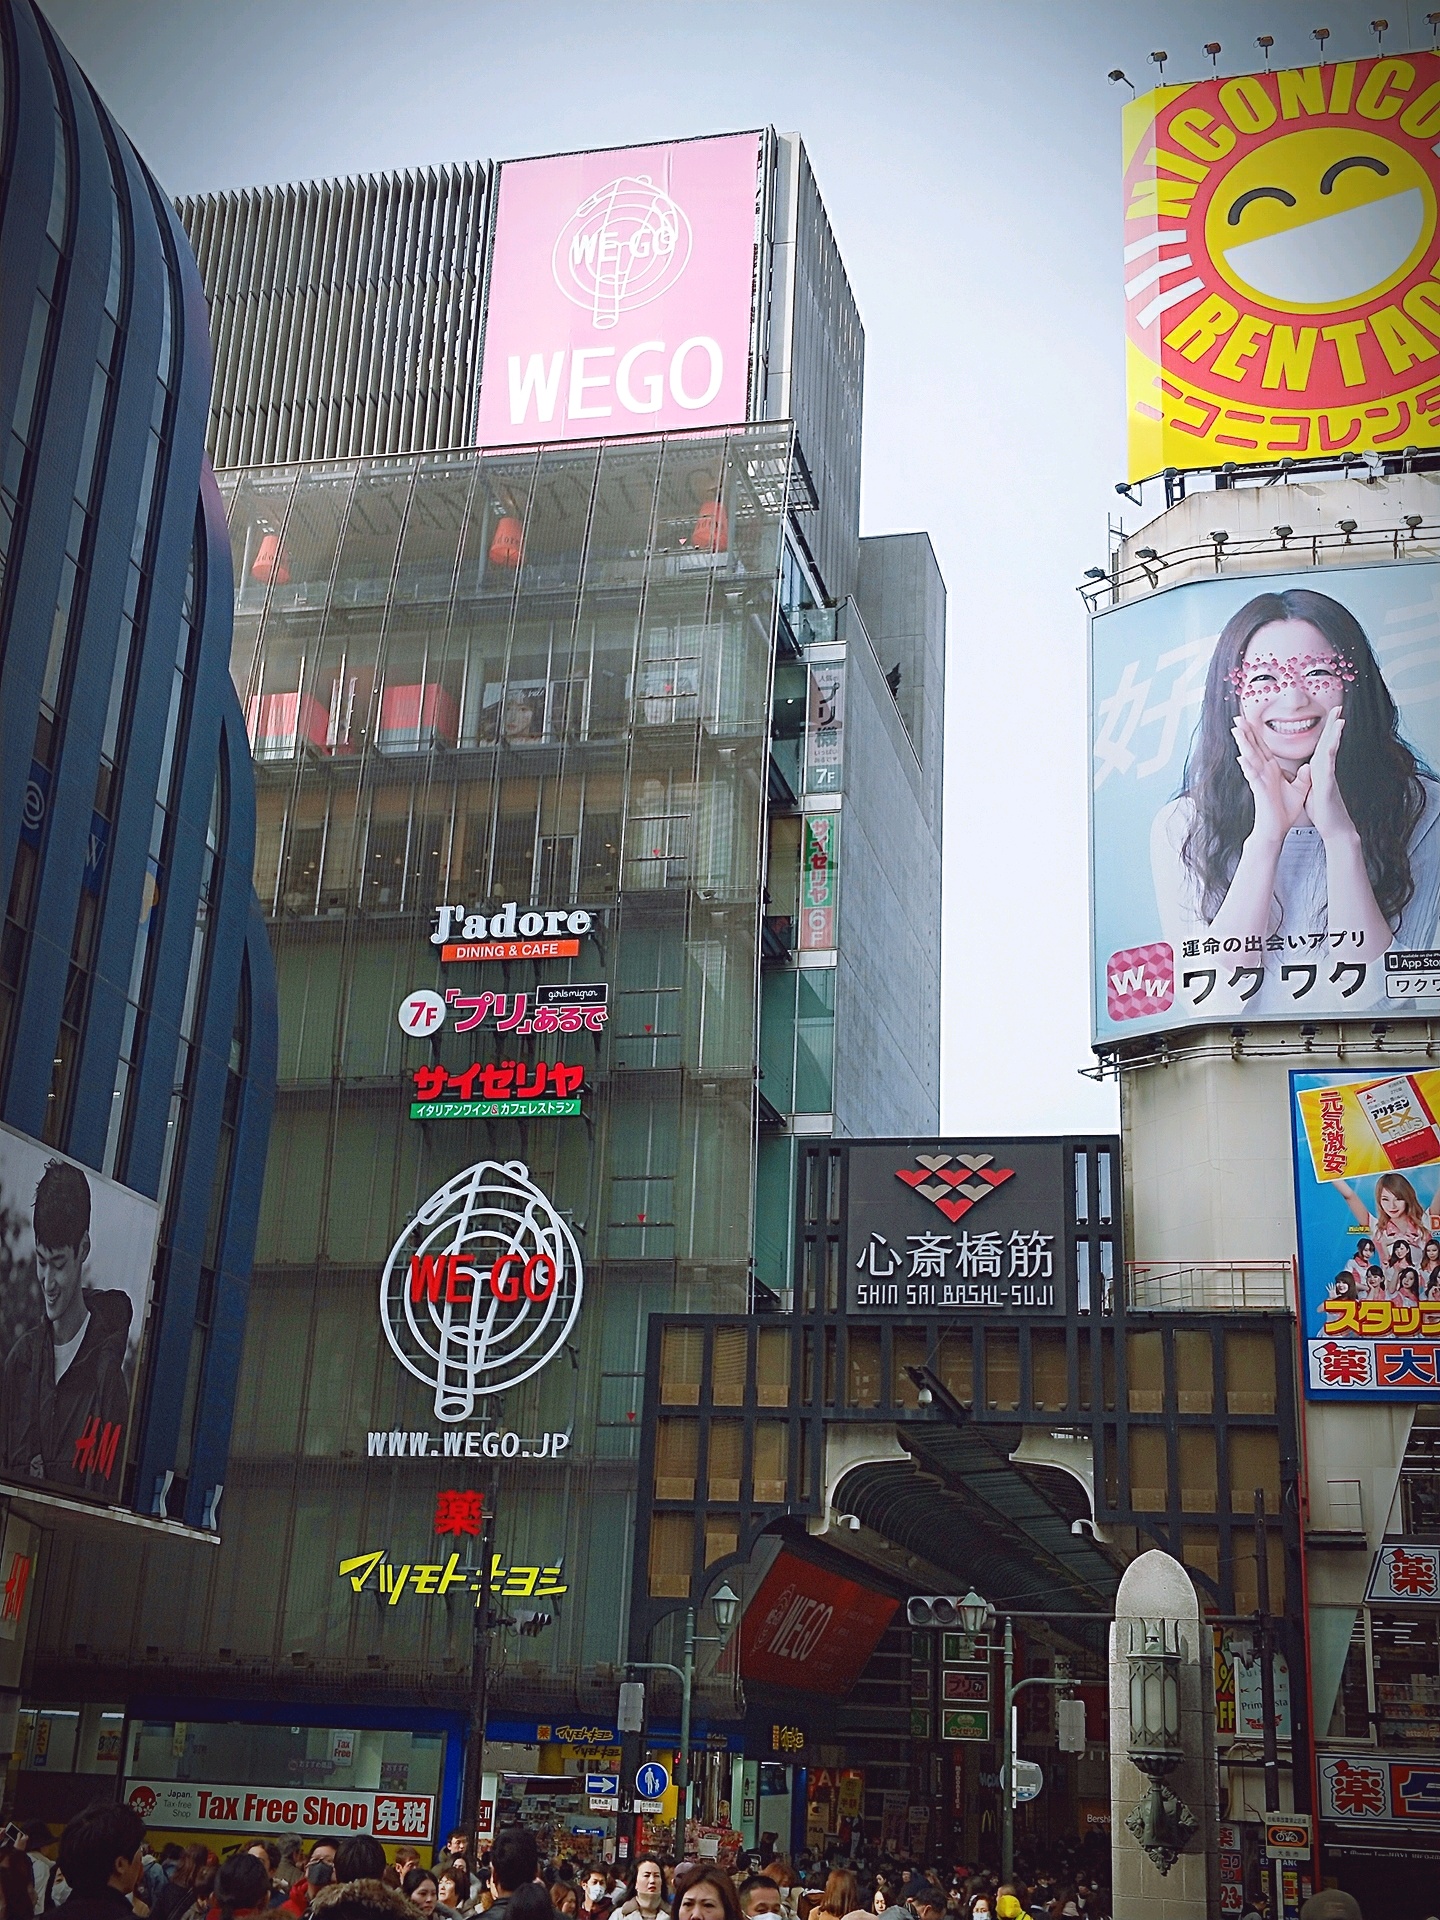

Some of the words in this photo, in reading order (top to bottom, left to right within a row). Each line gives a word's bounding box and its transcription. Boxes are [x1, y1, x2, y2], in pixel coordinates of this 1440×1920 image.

[1163, 281, 1440, 392] RENTAC
[508, 336, 724, 425] WEGO
[816, 768, 835, 784] 7F
[809, 819, 831, 905] サイゼリヤ
[430, 901, 592, 945] J'adore
[456, 945, 504, 959] DINING
[508, 945, 518, 956] &
[521, 943, 559, 956] CAFE
[1182, 929, 1367, 958] 運命の出会いアプリ
[1401, 959, 1422, 970] App
[1182, 961, 1368, 1006] ワクワク
[409, 1002, 438, 1027] 7F
[413, 1061, 584, 1101] サイゼリヤ
[1371, 1098, 1410, 1120] アリナミン
[1375, 1107, 1415, 1134] EX
[1319, 1090, 1348, 1175] 元気激安
[856, 1229, 1055, 1279] 心斎橋筋
[857, 1284, 898, 1306] SHIN
[1313, 1341, 1372, 1388] 薬
[1384, 1346, 1440, 1384] 大
[367, 1431, 570, 1459] WWW.WEGO.JP
[434, 1489, 486, 1537] 薬
[1382, 1547, 1438, 1597] 薬
[767, 1594, 834, 1661] WEGO
[1215, 1701, 1236, 1729] FF
[336, 1739, 350, 1749] Tax
[555, 1726, 614, 1743] マツモトキヨシ
[334, 1748, 351, 1759] Free
[1323, 1759, 1387, 1817] 薬
[172, 1808, 191, 1820] Shop
[197, 1790, 240, 1821] Tax
[243, 1793, 298, 1825] Free
[303, 1795, 368, 1830] Shop
[376, 1798, 428, 1834] 免税
